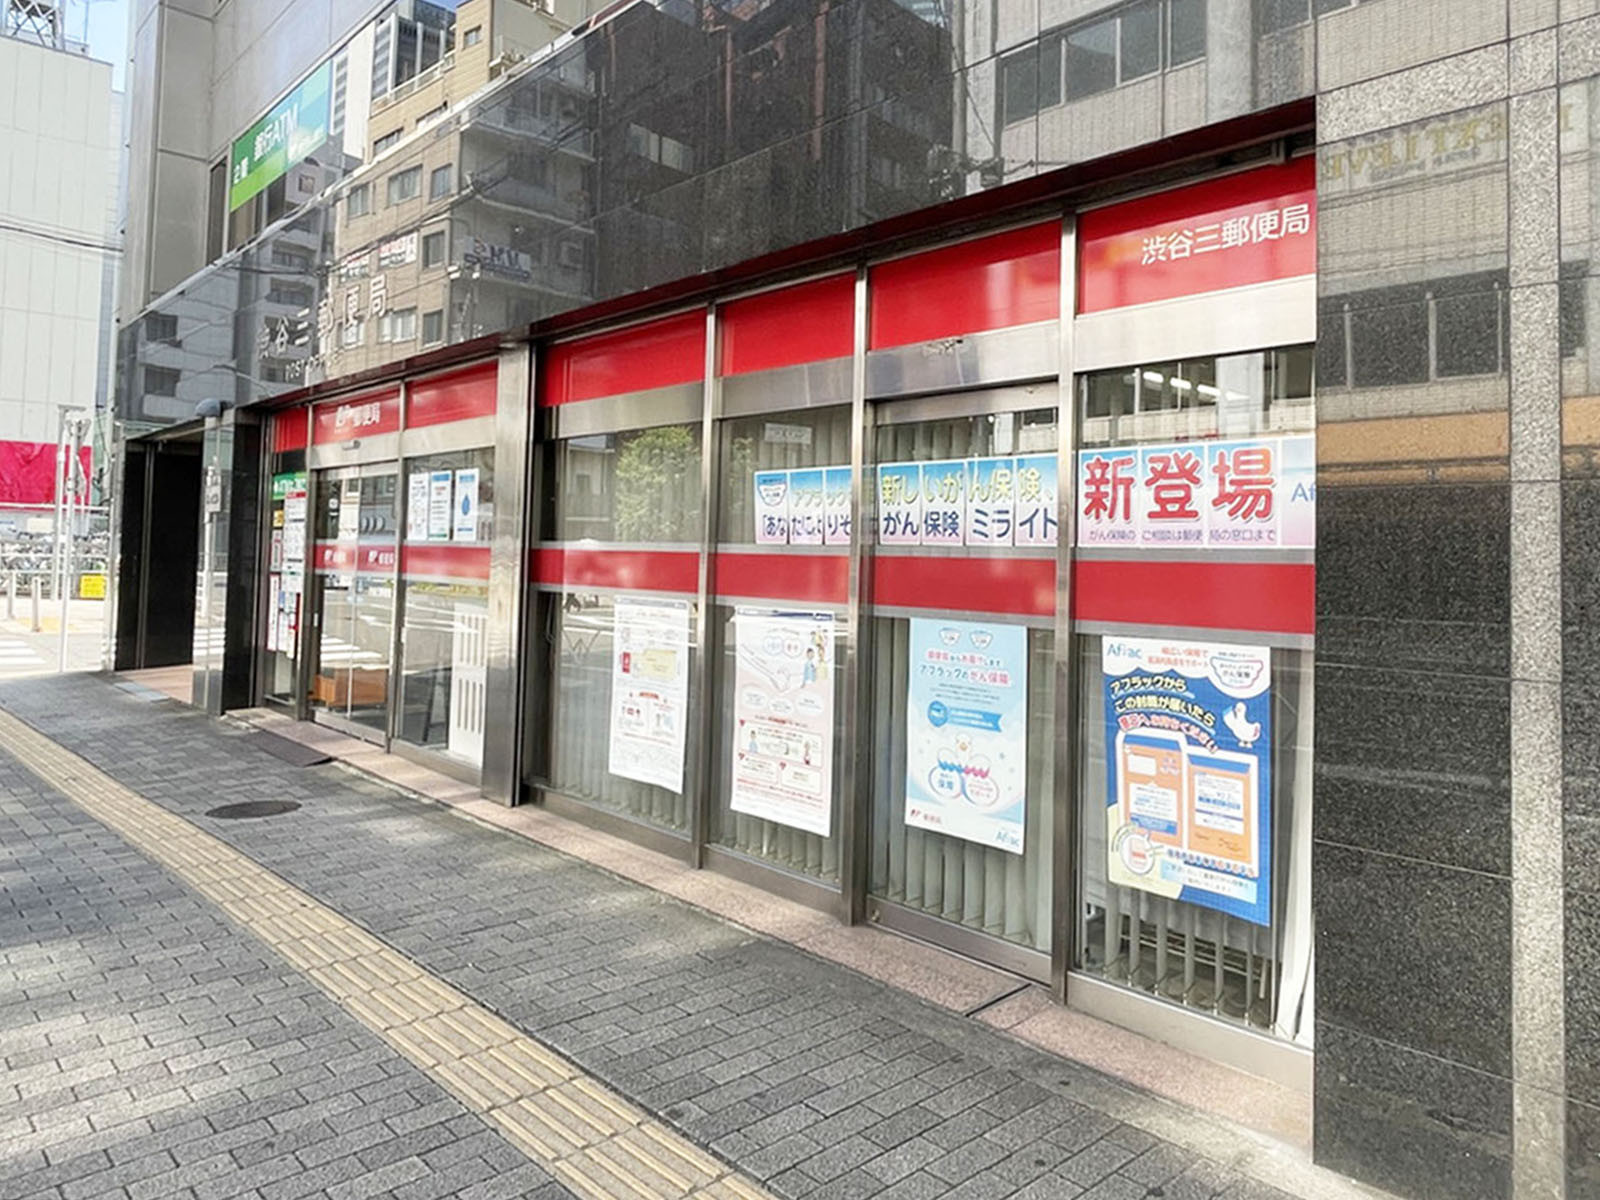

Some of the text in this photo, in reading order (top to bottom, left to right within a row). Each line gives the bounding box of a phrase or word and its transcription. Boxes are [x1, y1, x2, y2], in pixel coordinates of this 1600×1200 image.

[1141, 203, 1310, 265] 渋谷三郵便局
[1083, 447, 1276, 522] 新登場
[1106, 643, 1142, 659] Aflac
[1110, 675, 1187, 693] アフラックから
